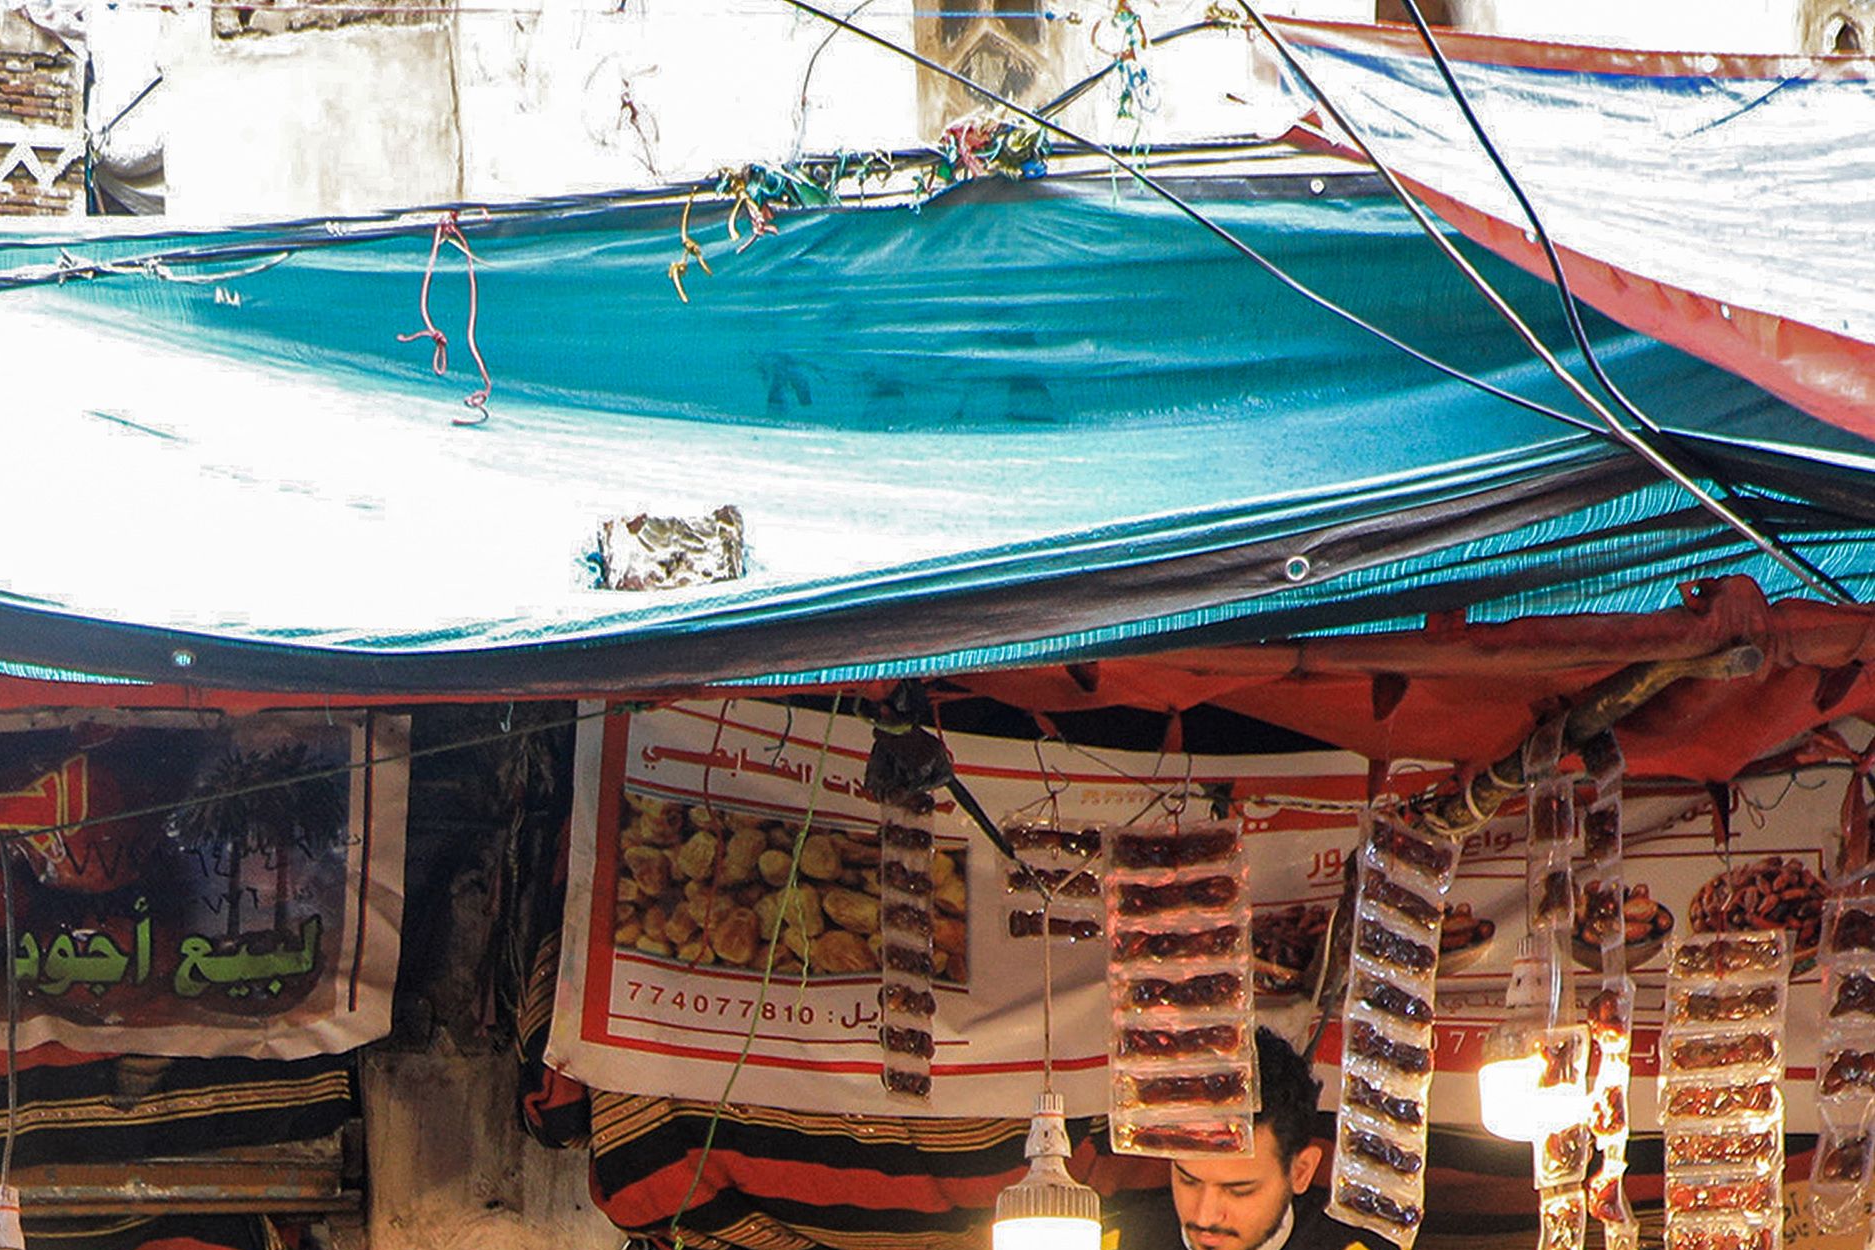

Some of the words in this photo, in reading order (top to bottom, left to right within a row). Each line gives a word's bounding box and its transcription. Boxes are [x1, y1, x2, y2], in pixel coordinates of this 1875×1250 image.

[15, 897, 152, 997] أجود
[175, 914, 322, 997] لبيع
[627, 980, 815, 1026] 774077810
